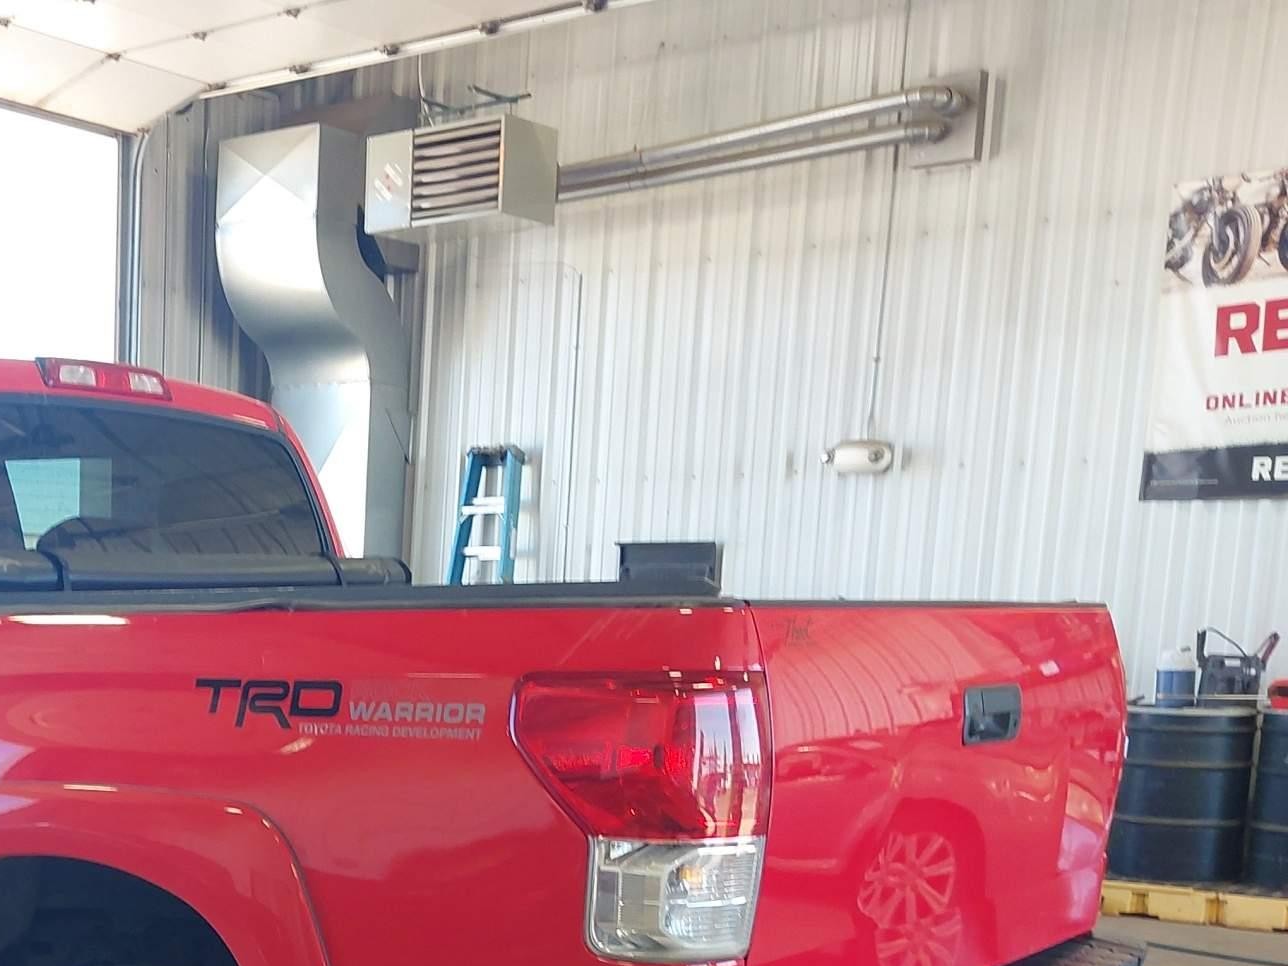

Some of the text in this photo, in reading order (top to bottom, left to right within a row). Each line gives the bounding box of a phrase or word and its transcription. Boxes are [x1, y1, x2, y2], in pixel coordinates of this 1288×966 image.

[1214, 298, 1288, 356] RE
[1251, 455, 1288, 481] RE
[196, 679, 343, 729] TRD
[349, 700, 486, 725] WARRIOR
[298, 722, 482, 741] TOYOTA RACING DEVELOPMENT
